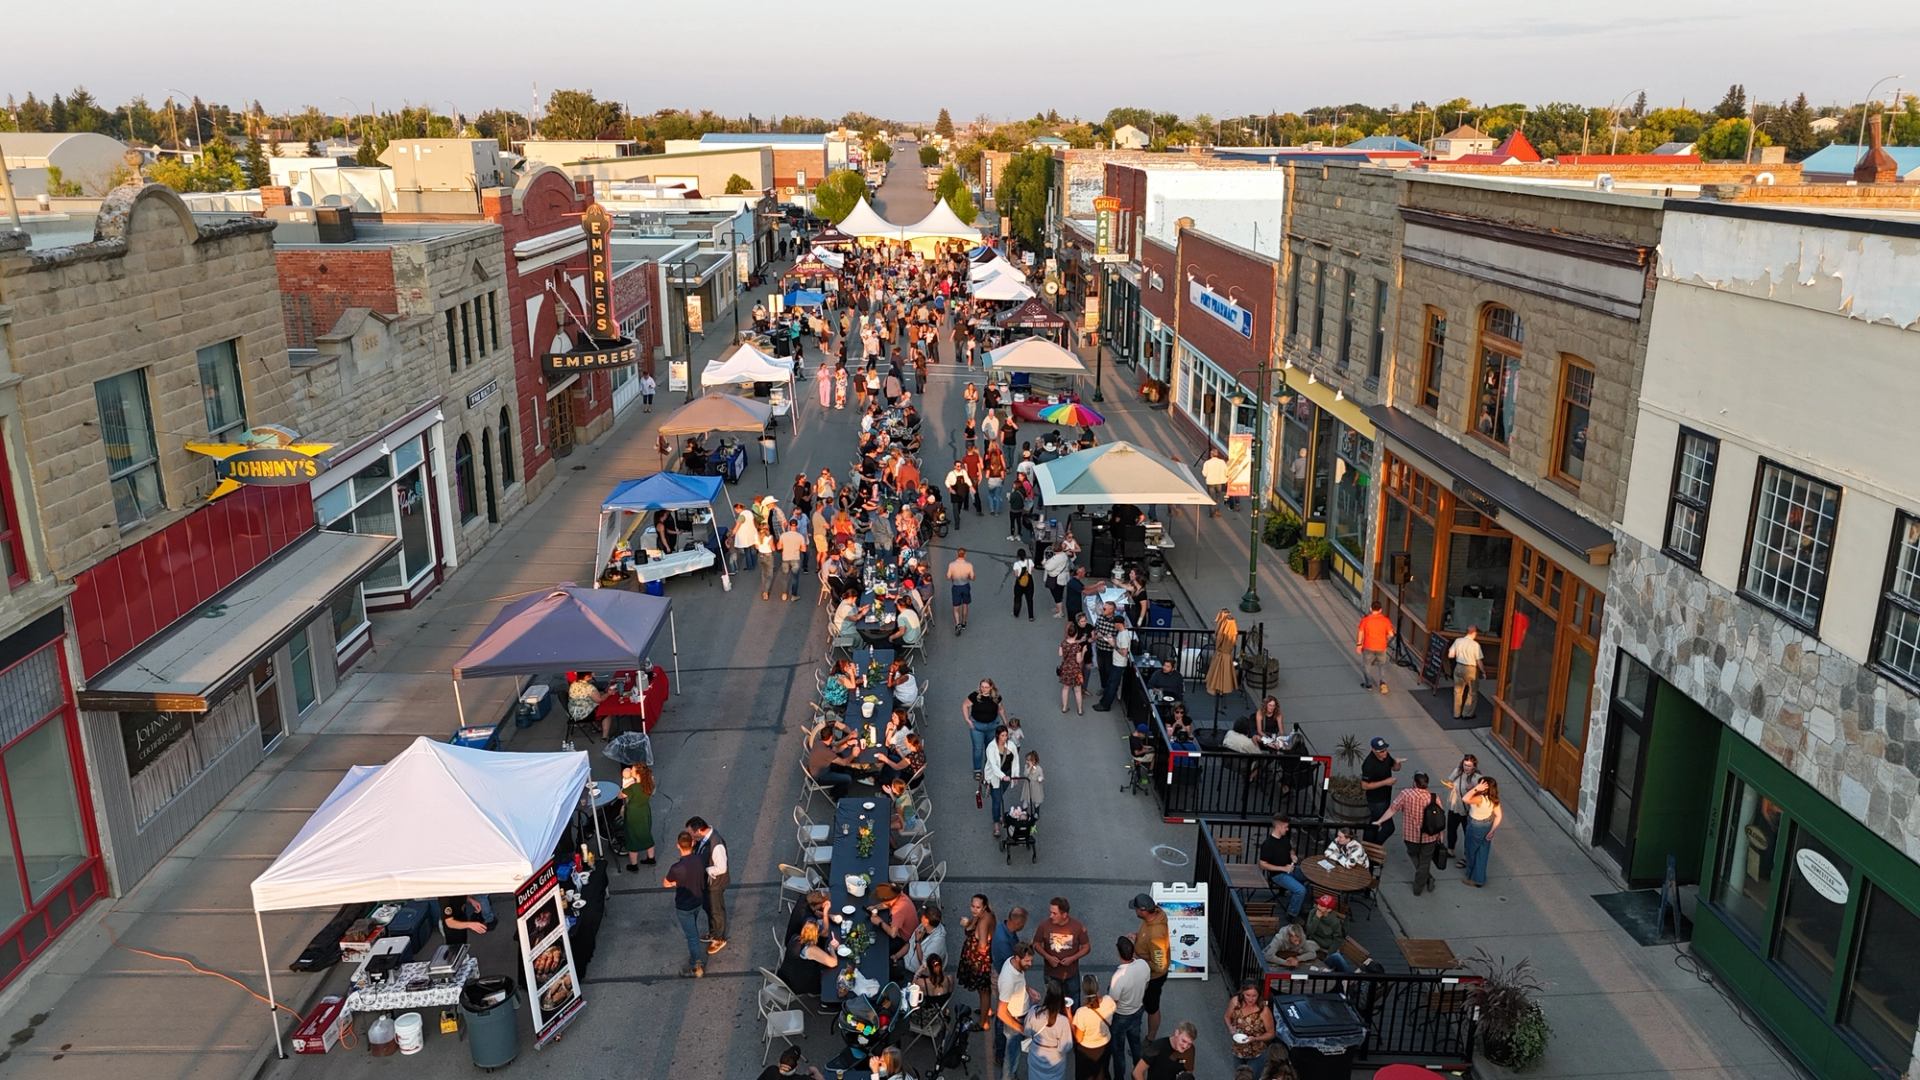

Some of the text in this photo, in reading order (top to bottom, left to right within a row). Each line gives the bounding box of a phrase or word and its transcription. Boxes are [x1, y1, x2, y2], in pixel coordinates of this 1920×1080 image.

[1095, 199, 1119, 210] GRILL
[1099, 210, 1108, 247] CAFE
[591, 221, 607, 332] EMPRESS
[552, 348, 637, 369] EMPRESS
[229, 457, 317, 478] JOHNNY'S
[517, 882, 539, 905] Dutch
[538, 866, 555, 886] Grill
